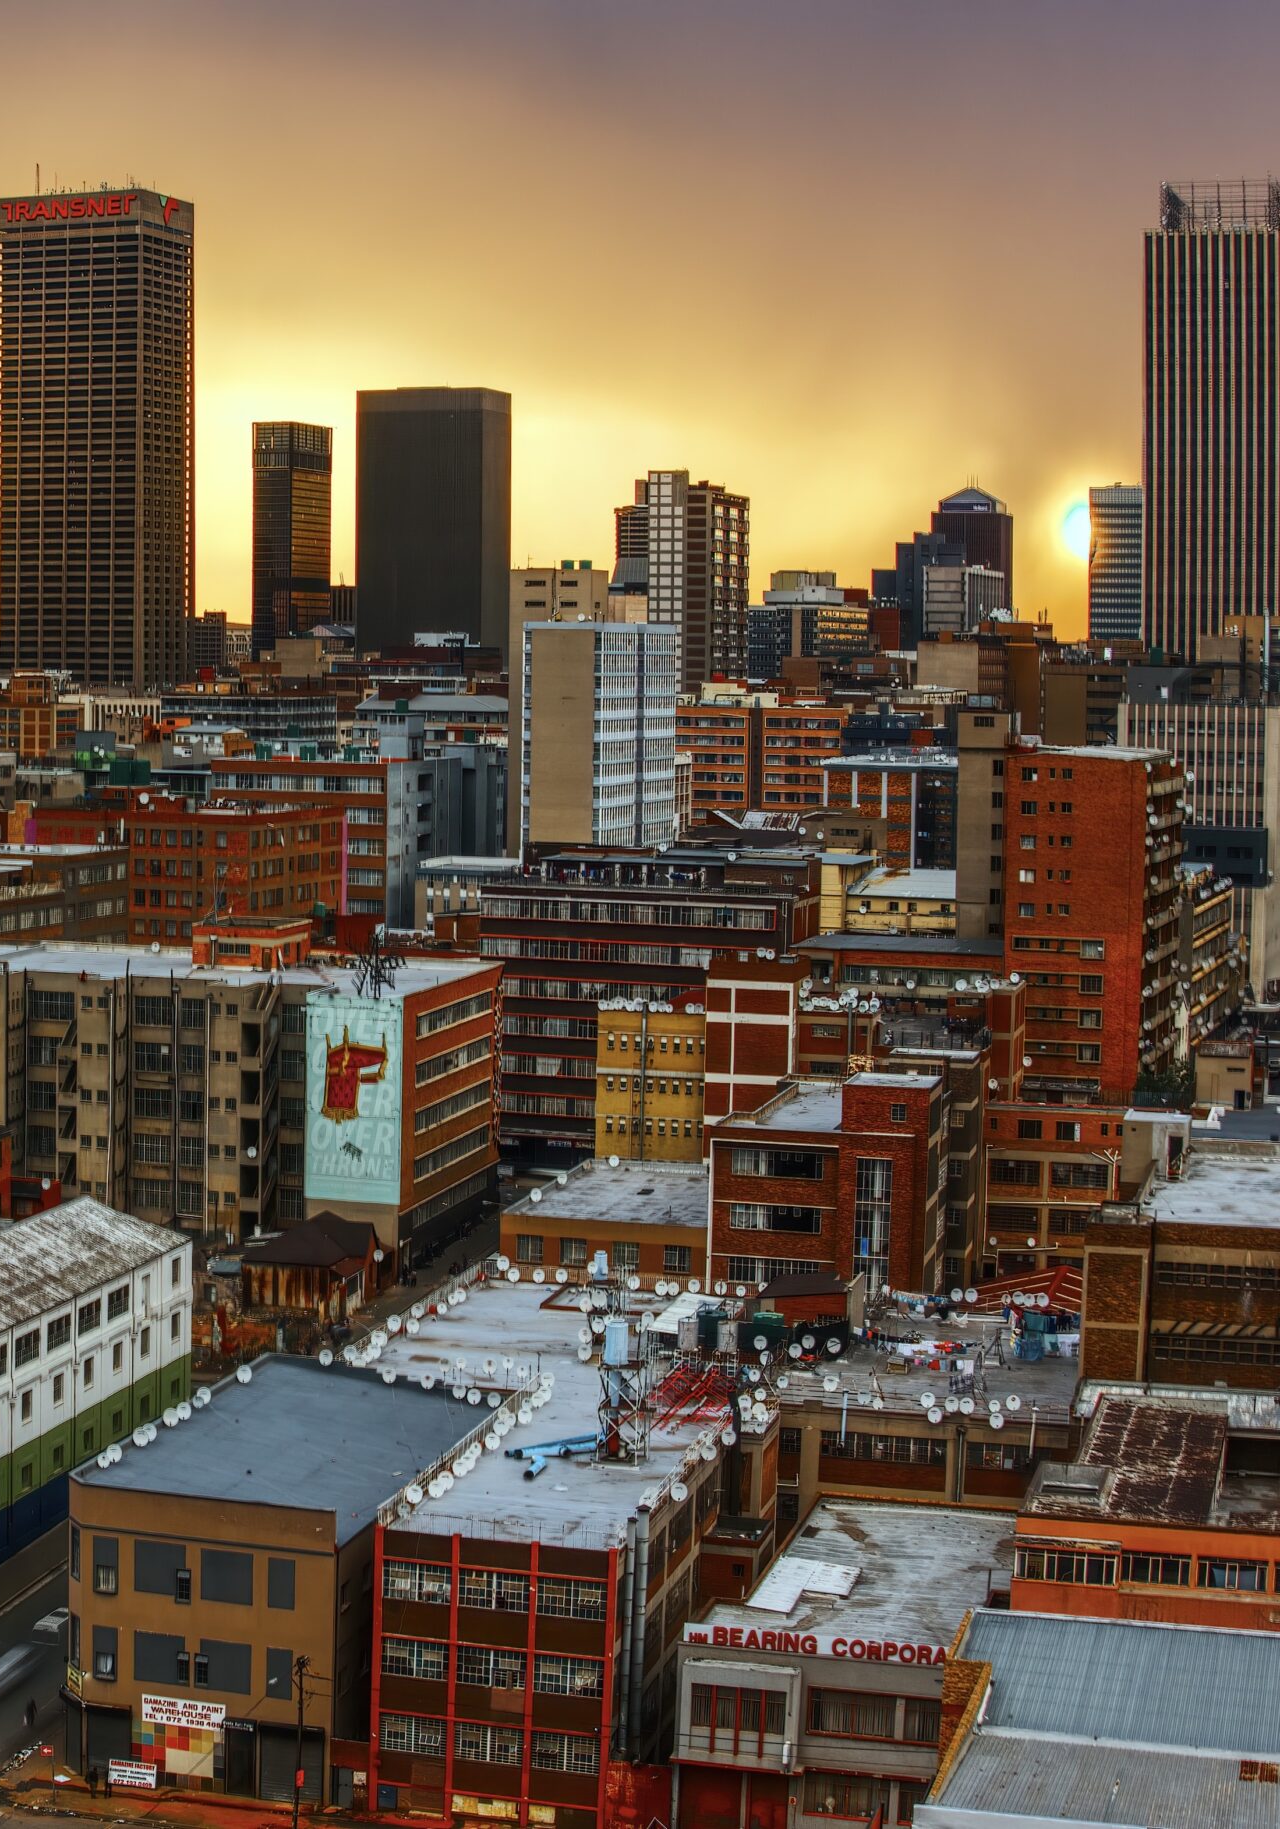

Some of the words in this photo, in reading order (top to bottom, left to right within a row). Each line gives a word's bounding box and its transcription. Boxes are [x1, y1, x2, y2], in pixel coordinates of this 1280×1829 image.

[1, 195, 138, 223] TRANSNET
[311, 1081, 396, 1118] OER
[688, 1632, 708, 1645] HM
[712, 1625, 818, 1655] BEARING
[150, 1706, 212, 1720] WAREHOUSE
[182, 1702, 199, 1712] AND
[201, 1704, 224, 1714] PAINT
